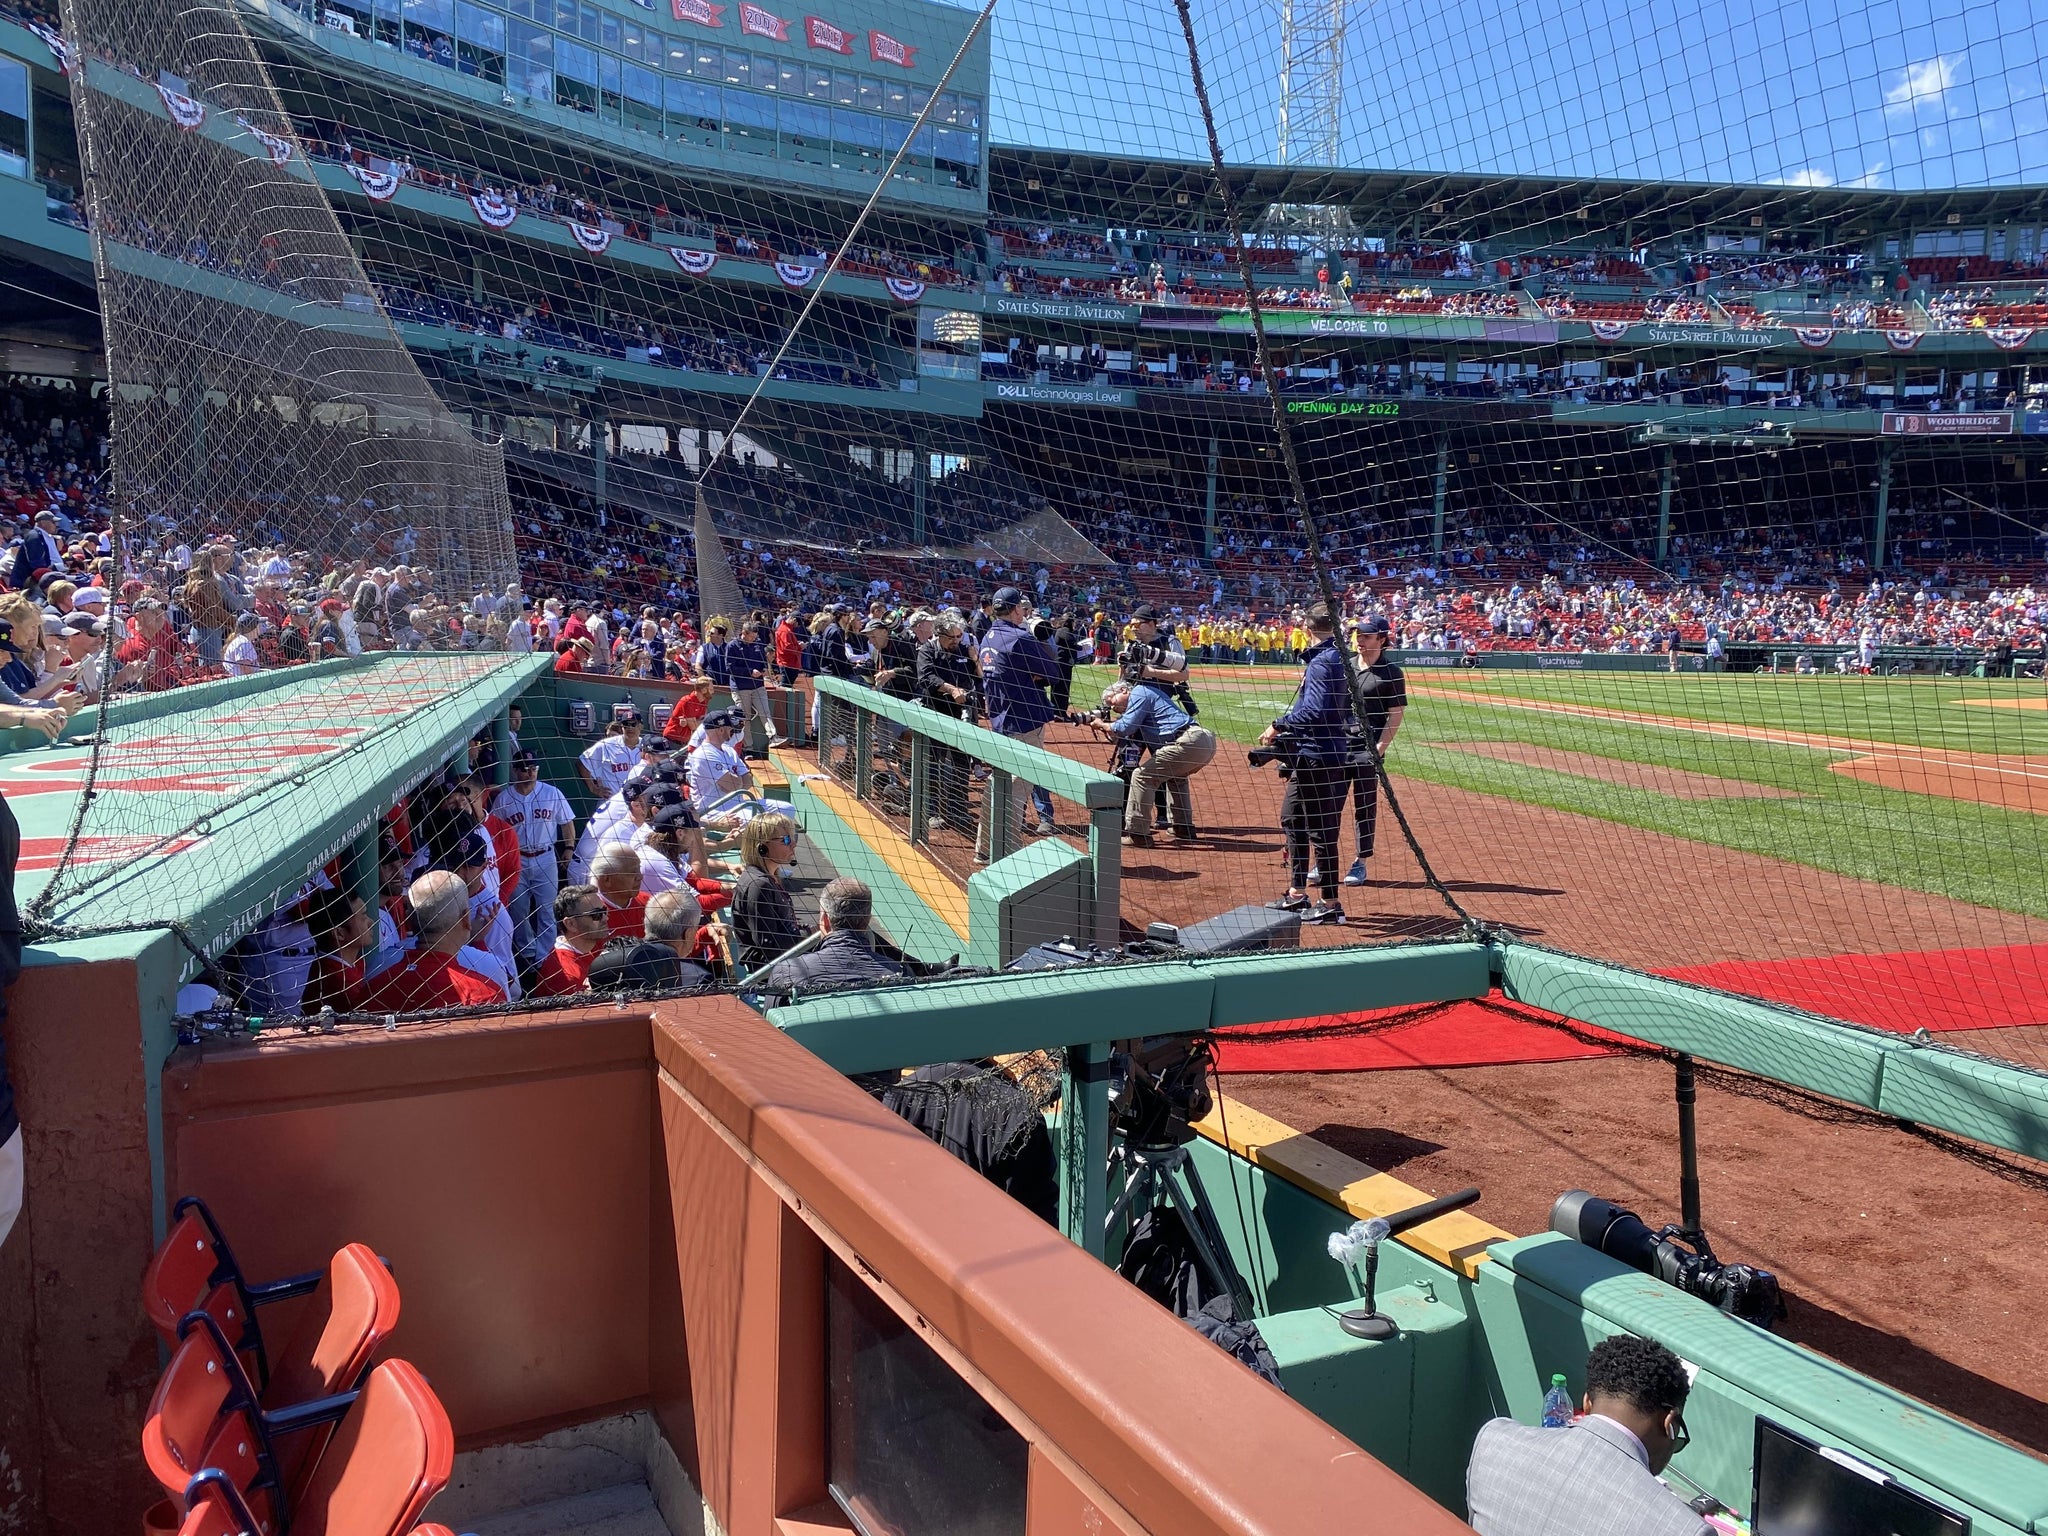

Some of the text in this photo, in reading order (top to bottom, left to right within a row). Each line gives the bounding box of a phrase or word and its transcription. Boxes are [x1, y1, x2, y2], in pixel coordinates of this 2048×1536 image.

[746, 10, 779, 33] 2007
[812, 24, 844, 46] 2013
[998, 300, 1125, 320] STATE STREET PAVILION
[1311, 319, 1387, 332] WELCOME TO
[1649, 329, 1772, 344] STATE STREET PAVILION
[998, 385, 1121, 402] DELL Technologies Level
[1287, 402, 1399, 415] OPENING DAY 2022
[1927, 416, 2001, 426] WOODBRIDGE
[1405, 657, 1454, 666] smartwater
[1537, 656, 1583, 668] TouchView
[611, 762, 629, 773] RED
[506, 808, 552, 826] RED SOX
